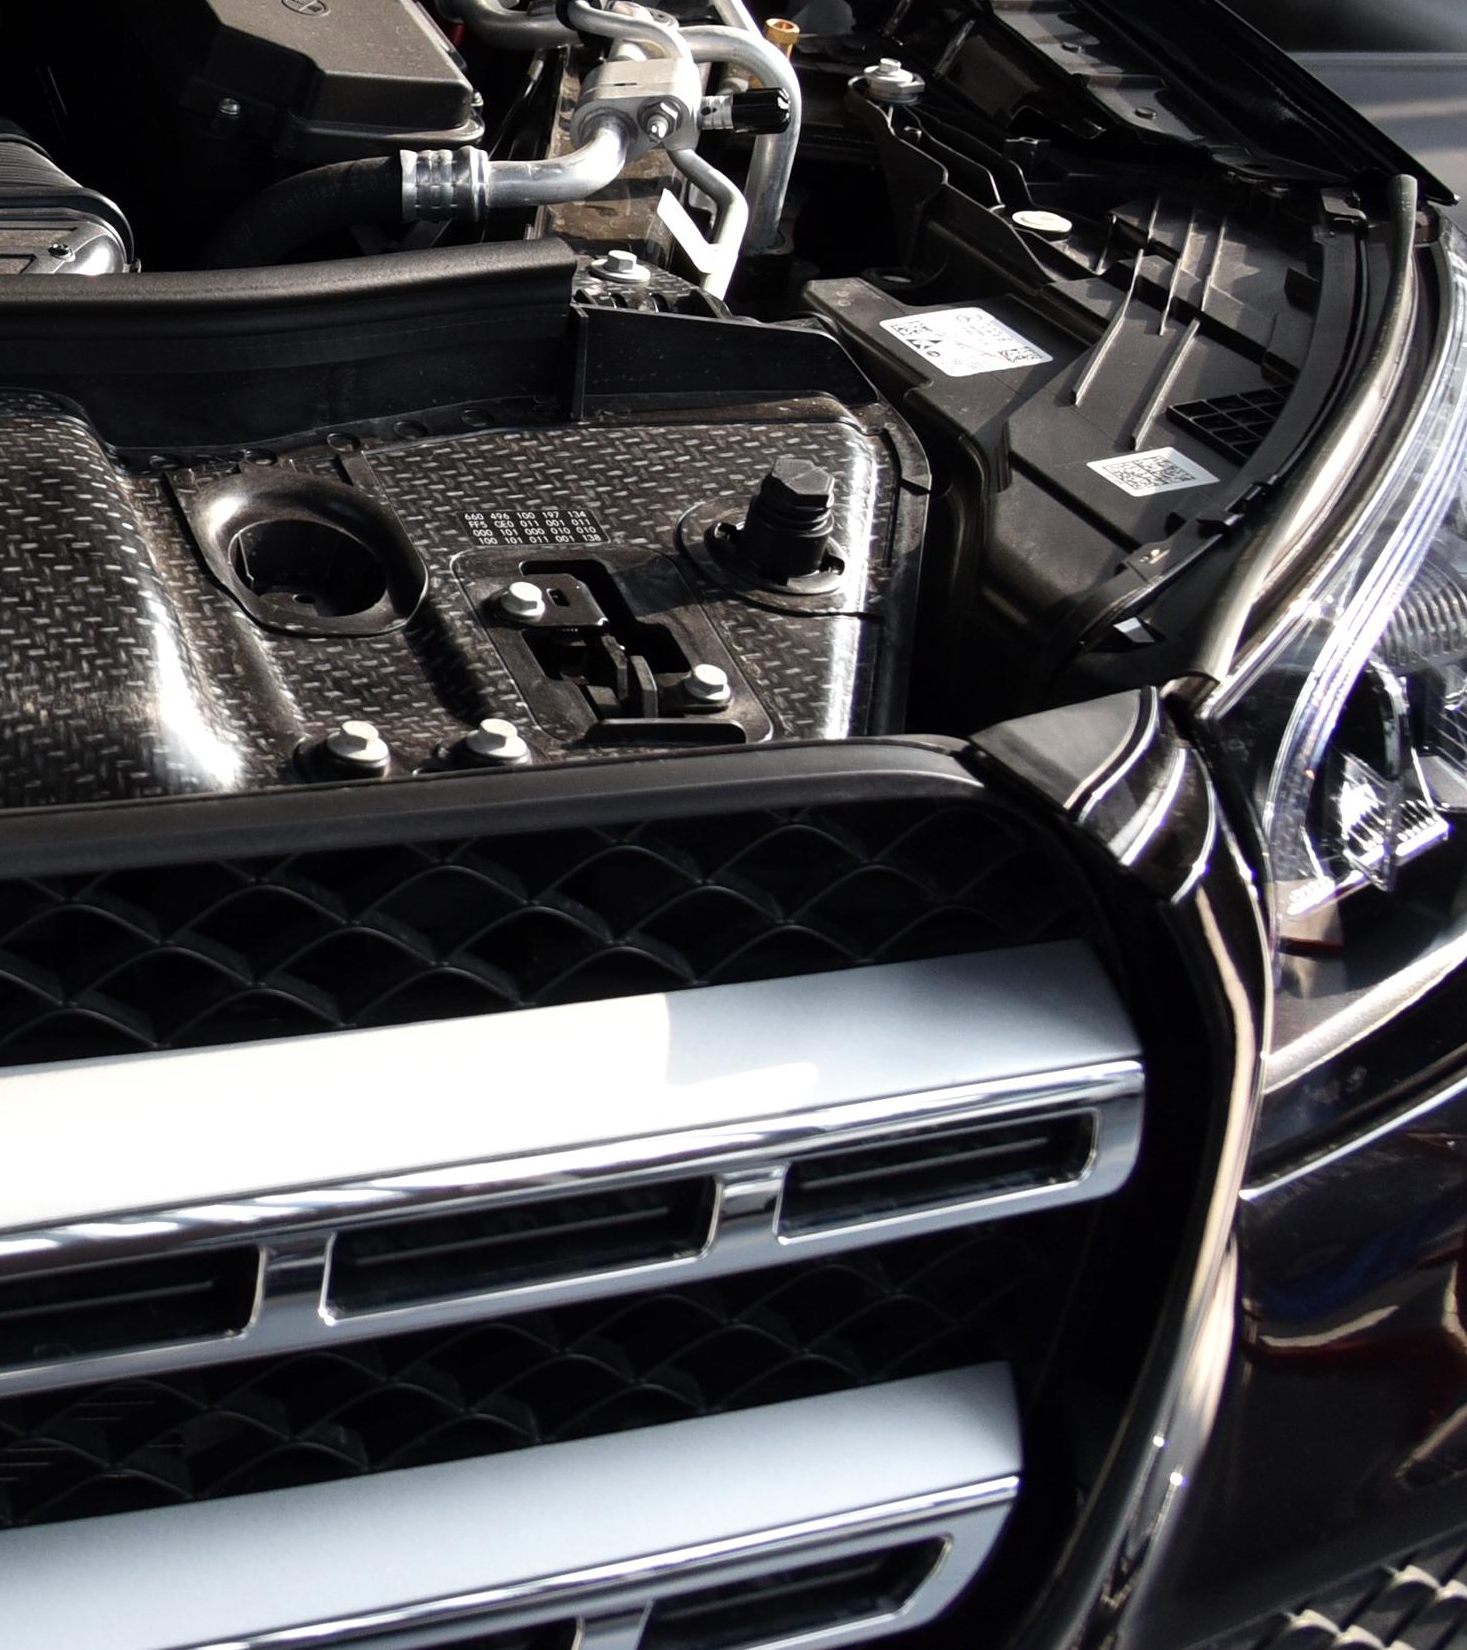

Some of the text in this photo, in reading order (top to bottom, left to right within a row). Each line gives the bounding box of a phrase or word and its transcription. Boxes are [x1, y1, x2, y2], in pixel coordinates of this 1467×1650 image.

[490, 512, 510, 520] 496
[542, 511, 560, 519] 197
[469, 521, 488, 529] FF5
[545, 519, 565, 527] 001
[473, 529, 493, 537] 000
[550, 527, 571, 535] 010
[576, 526, 597, 534] 010
[478, 537, 498, 545] 100
[529, 536, 549, 544] 011
[555, 535, 575, 543] 001
[582, 534, 602, 542] 138
